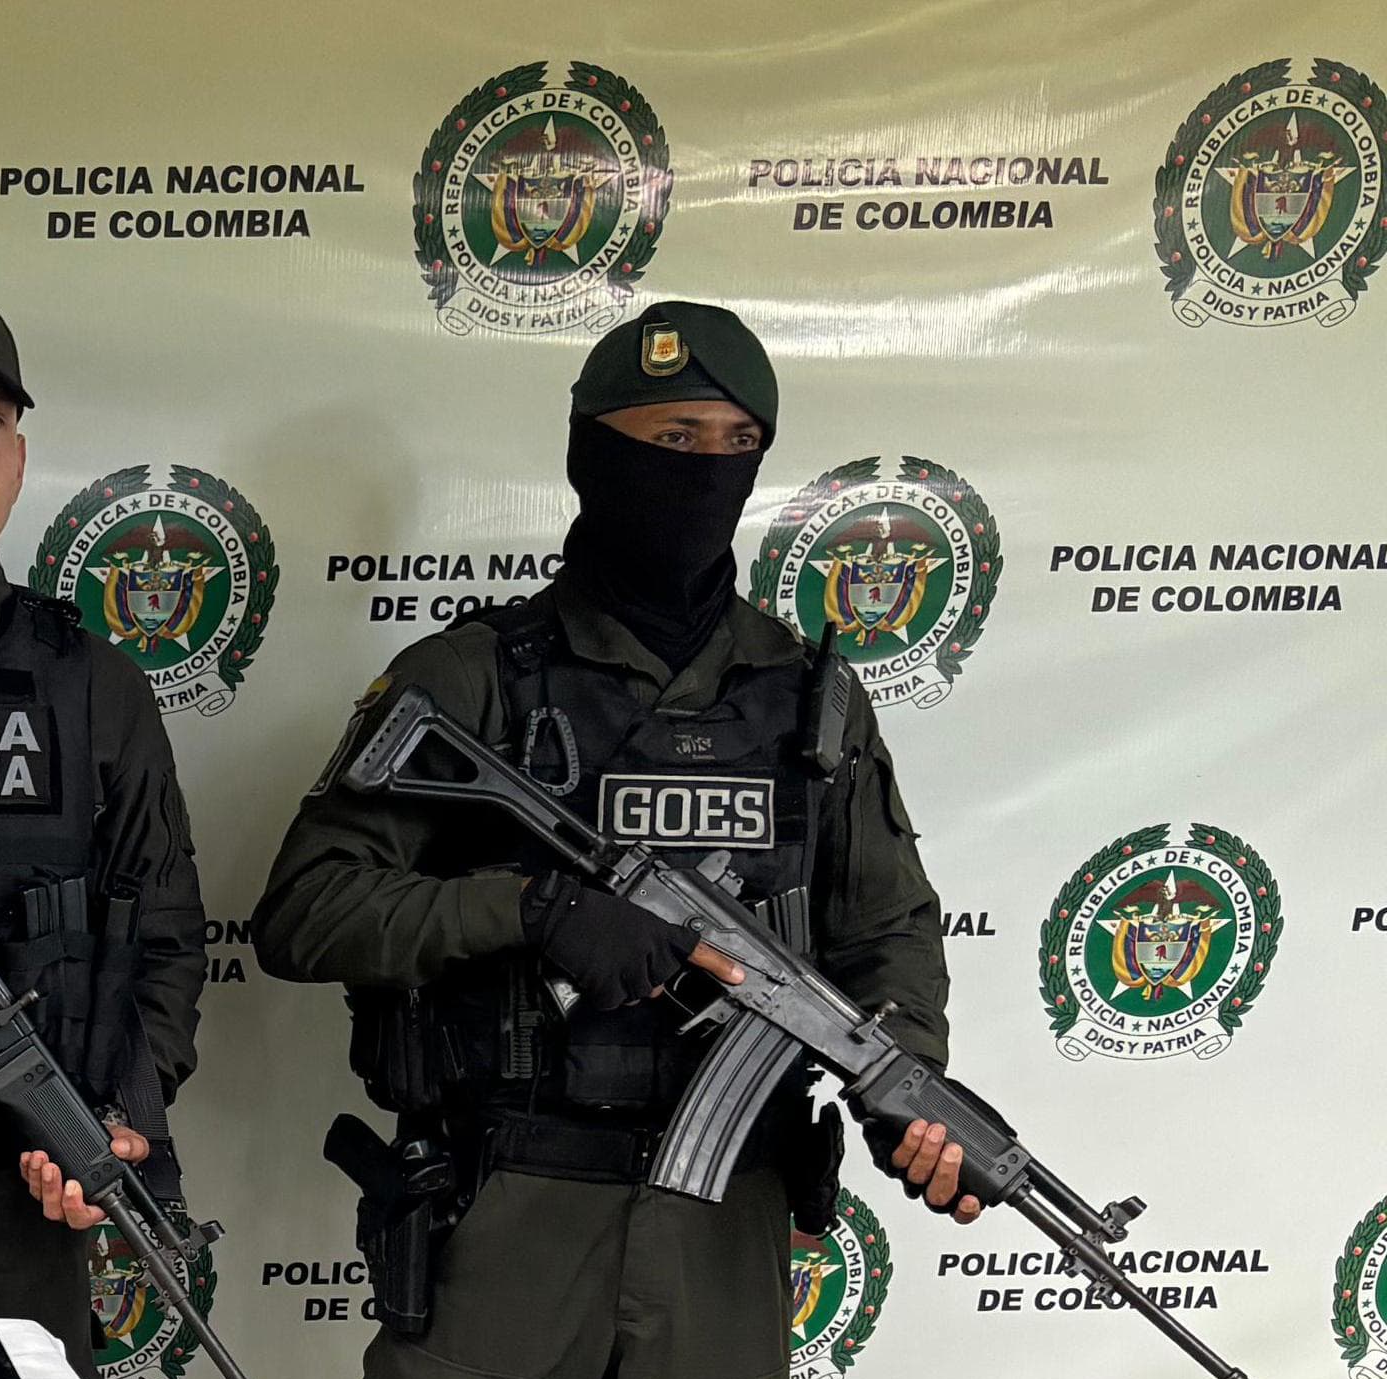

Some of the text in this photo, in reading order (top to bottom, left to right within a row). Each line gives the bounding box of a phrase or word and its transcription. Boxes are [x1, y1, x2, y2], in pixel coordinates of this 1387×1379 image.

[1285, 90, 1314, 105] DE
[1332, 102, 1379, 208] COLOMBIA
[0, 165, 364, 195] POLICIA NACIONAL
[748, 157, 1109, 187] POLICIA NACIONAL
[48, 209, 310, 238] DE COLOMBIA
[793, 201, 1053, 230] DE COLOMBIA
[1269, 232, 1361, 295] NACIONAL
[1264, 291, 1329, 320] PATRIA
[327, 555, 469, 582] POLICIA
[1050, 544, 1387, 571] POLICIA NACIONAL
[370, 596, 418, 621] DE
[1092, 585, 1341, 612] DE COLOMBIA
[613, 786, 765, 837] GOES
[1164, 851, 1191, 864] DE
[1208, 861, 1253, 954] COLOMBIA
[1148, 976, 1236, 1032] NACIONAL
[1144, 1028, 1205, 1054] PATRIA
[305, 1298, 349, 1321] DE
[978, 1289, 1023, 1311] DE
